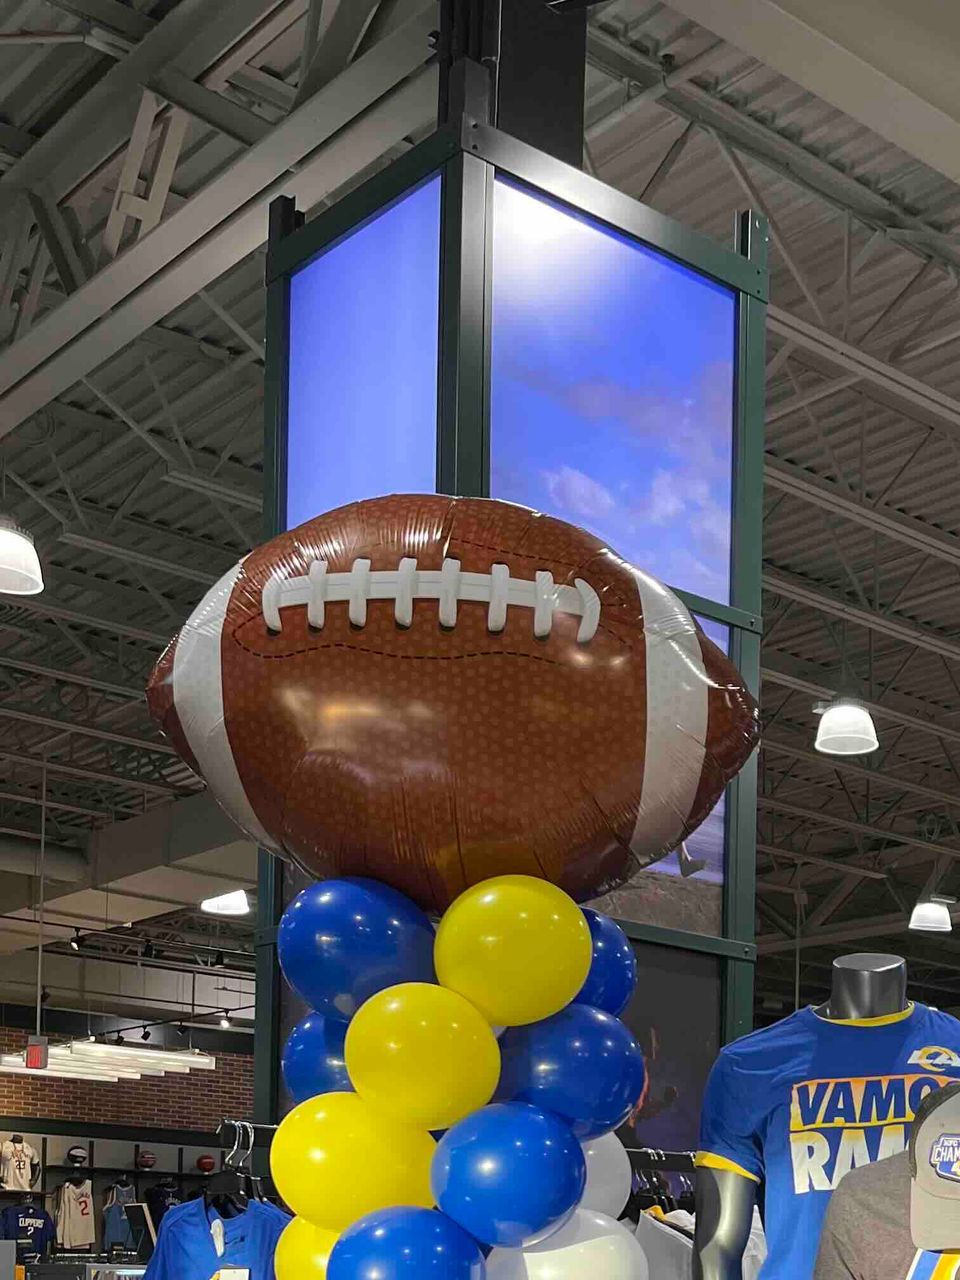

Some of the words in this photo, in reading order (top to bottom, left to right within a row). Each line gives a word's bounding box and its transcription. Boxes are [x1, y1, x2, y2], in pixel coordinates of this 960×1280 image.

[797, 1076, 958, 1126] VAMO
[79, 1200, 90, 1216] 2
[18, 1217, 45, 1229] CLIPPERS
